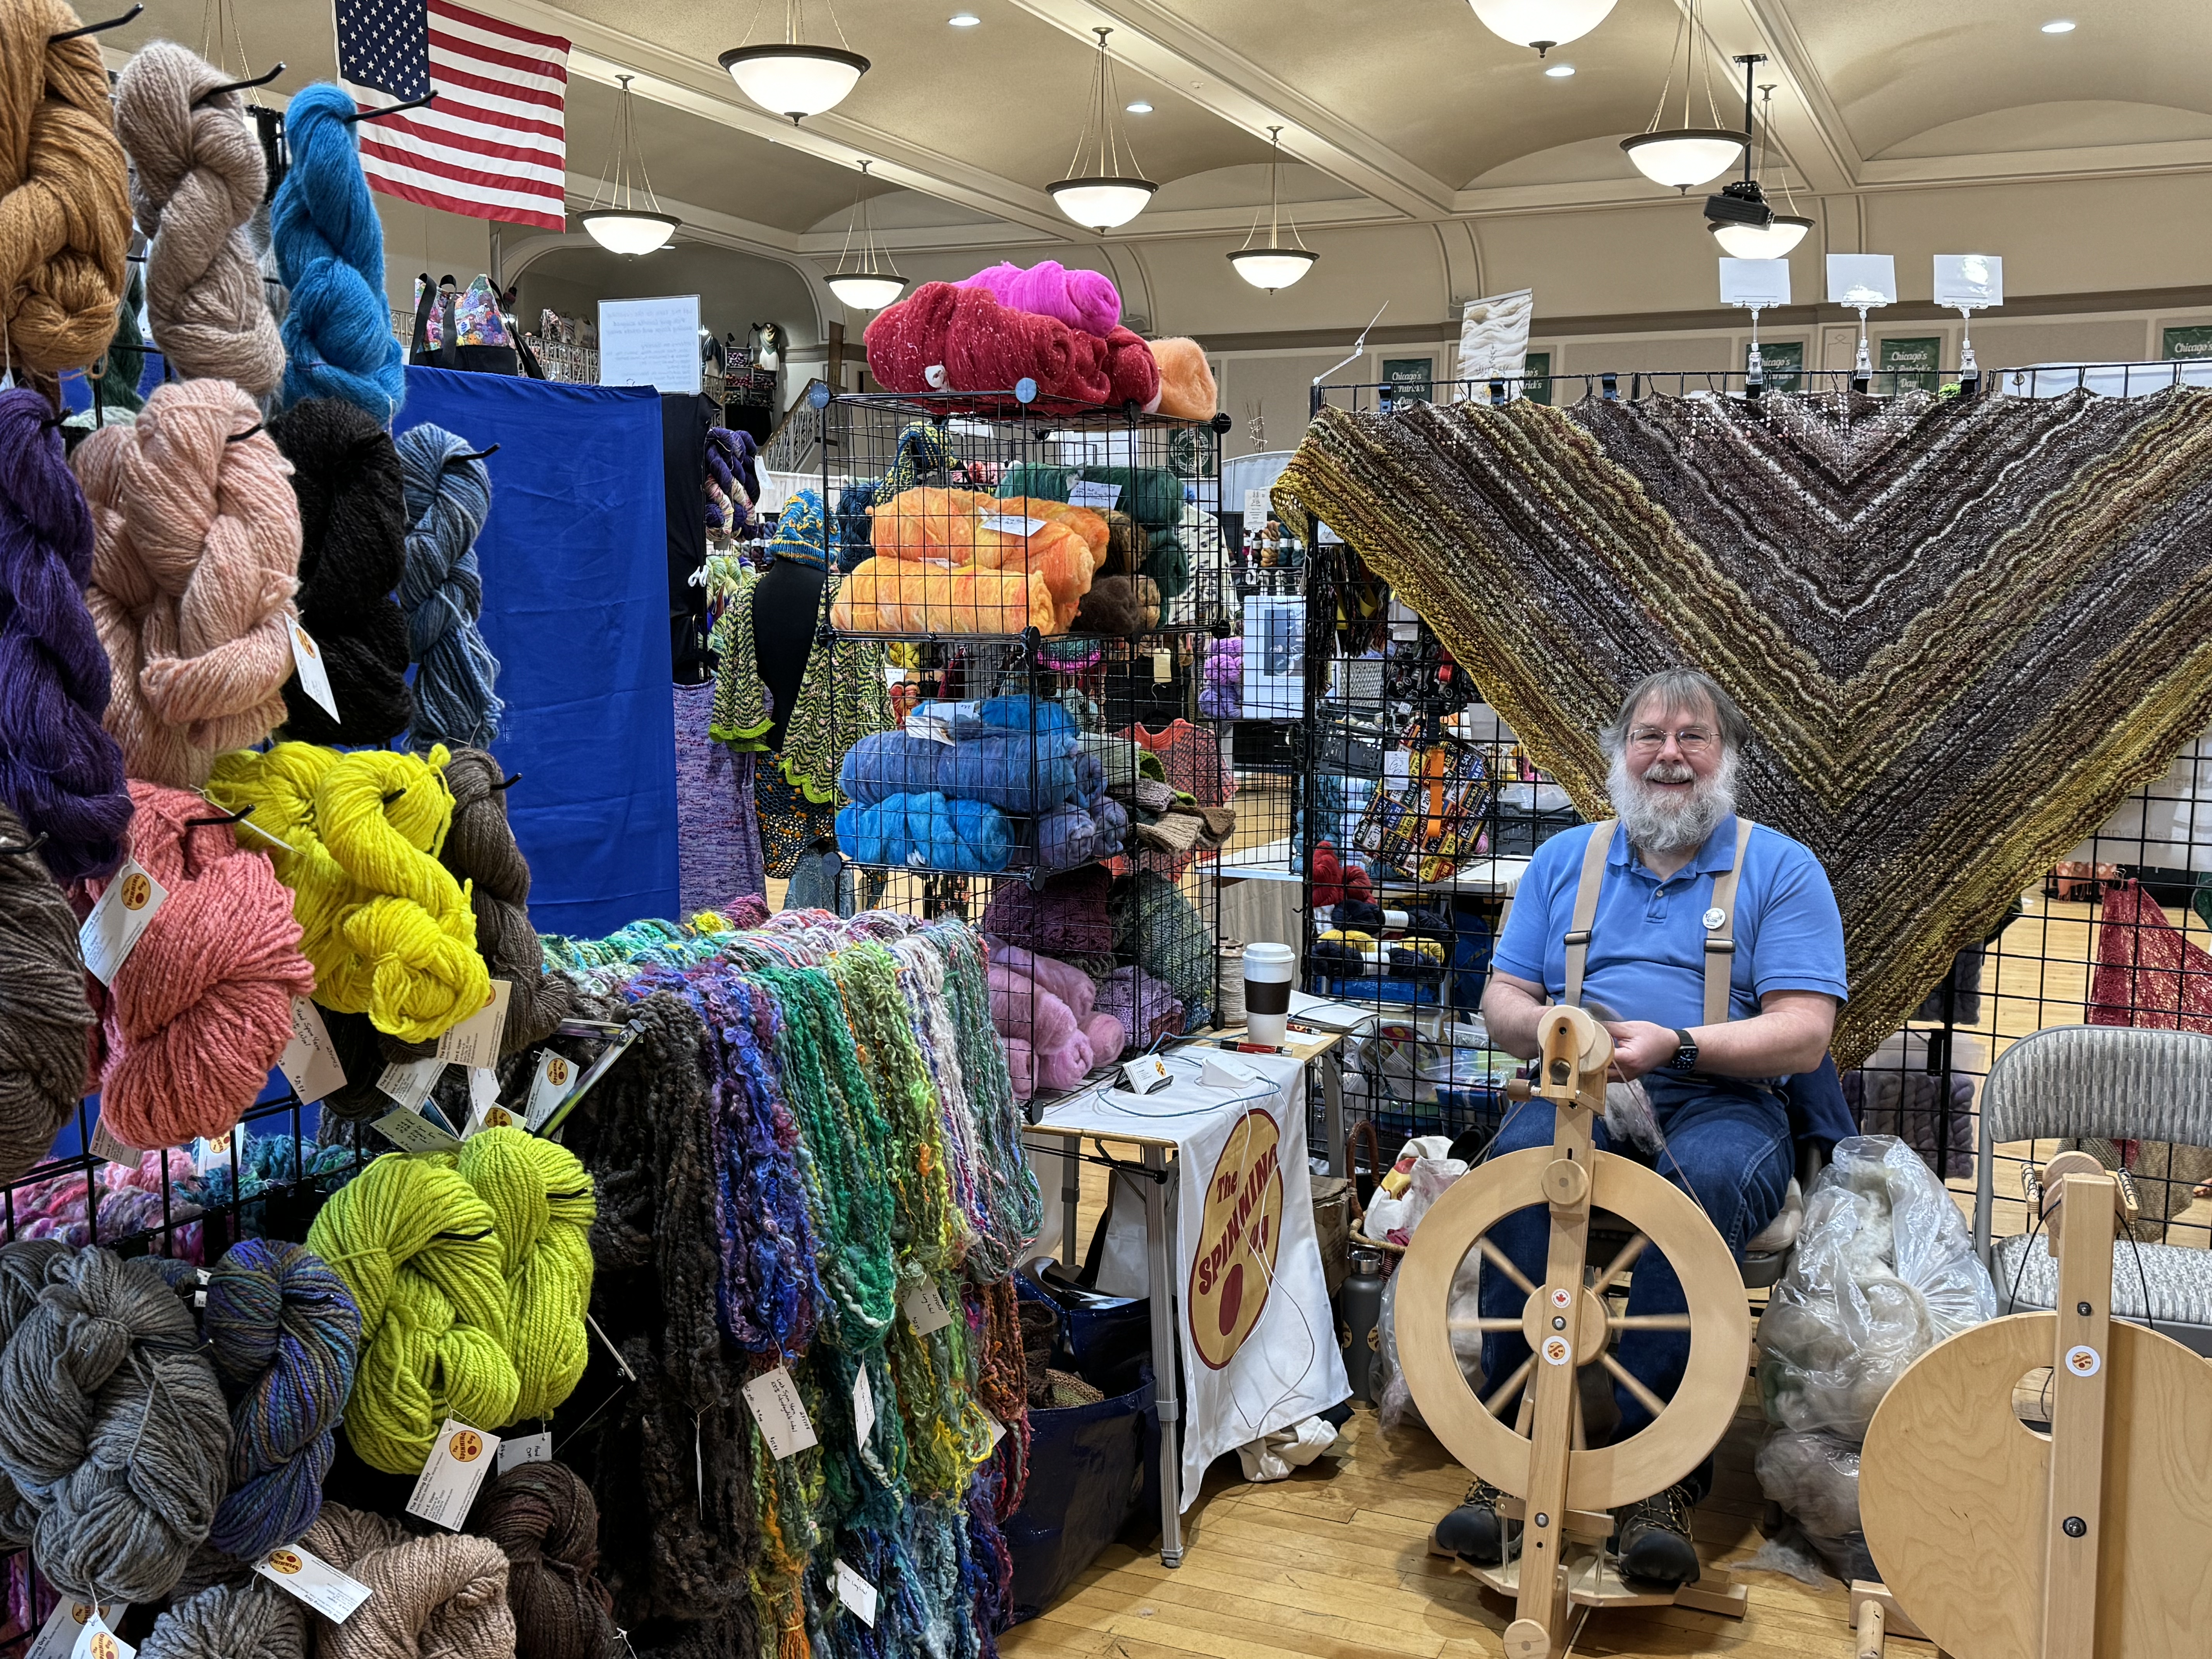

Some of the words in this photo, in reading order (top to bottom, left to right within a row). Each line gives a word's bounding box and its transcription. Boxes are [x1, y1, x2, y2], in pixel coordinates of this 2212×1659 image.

[1892, 350, 1928, 363] Chicago's
[1761, 357, 1791, 369] hicago's
[1392, 371, 1422, 382] Chicago's
[1900, 378, 1917, 390] Day
[1399, 396, 1413, 405] Day
[127, 874, 141, 908] SPINNING
[1216, 1170, 1238, 1204] The
[467, 1435, 476, 1444] Guy
[414, 1481, 426, 1501] Spinning
